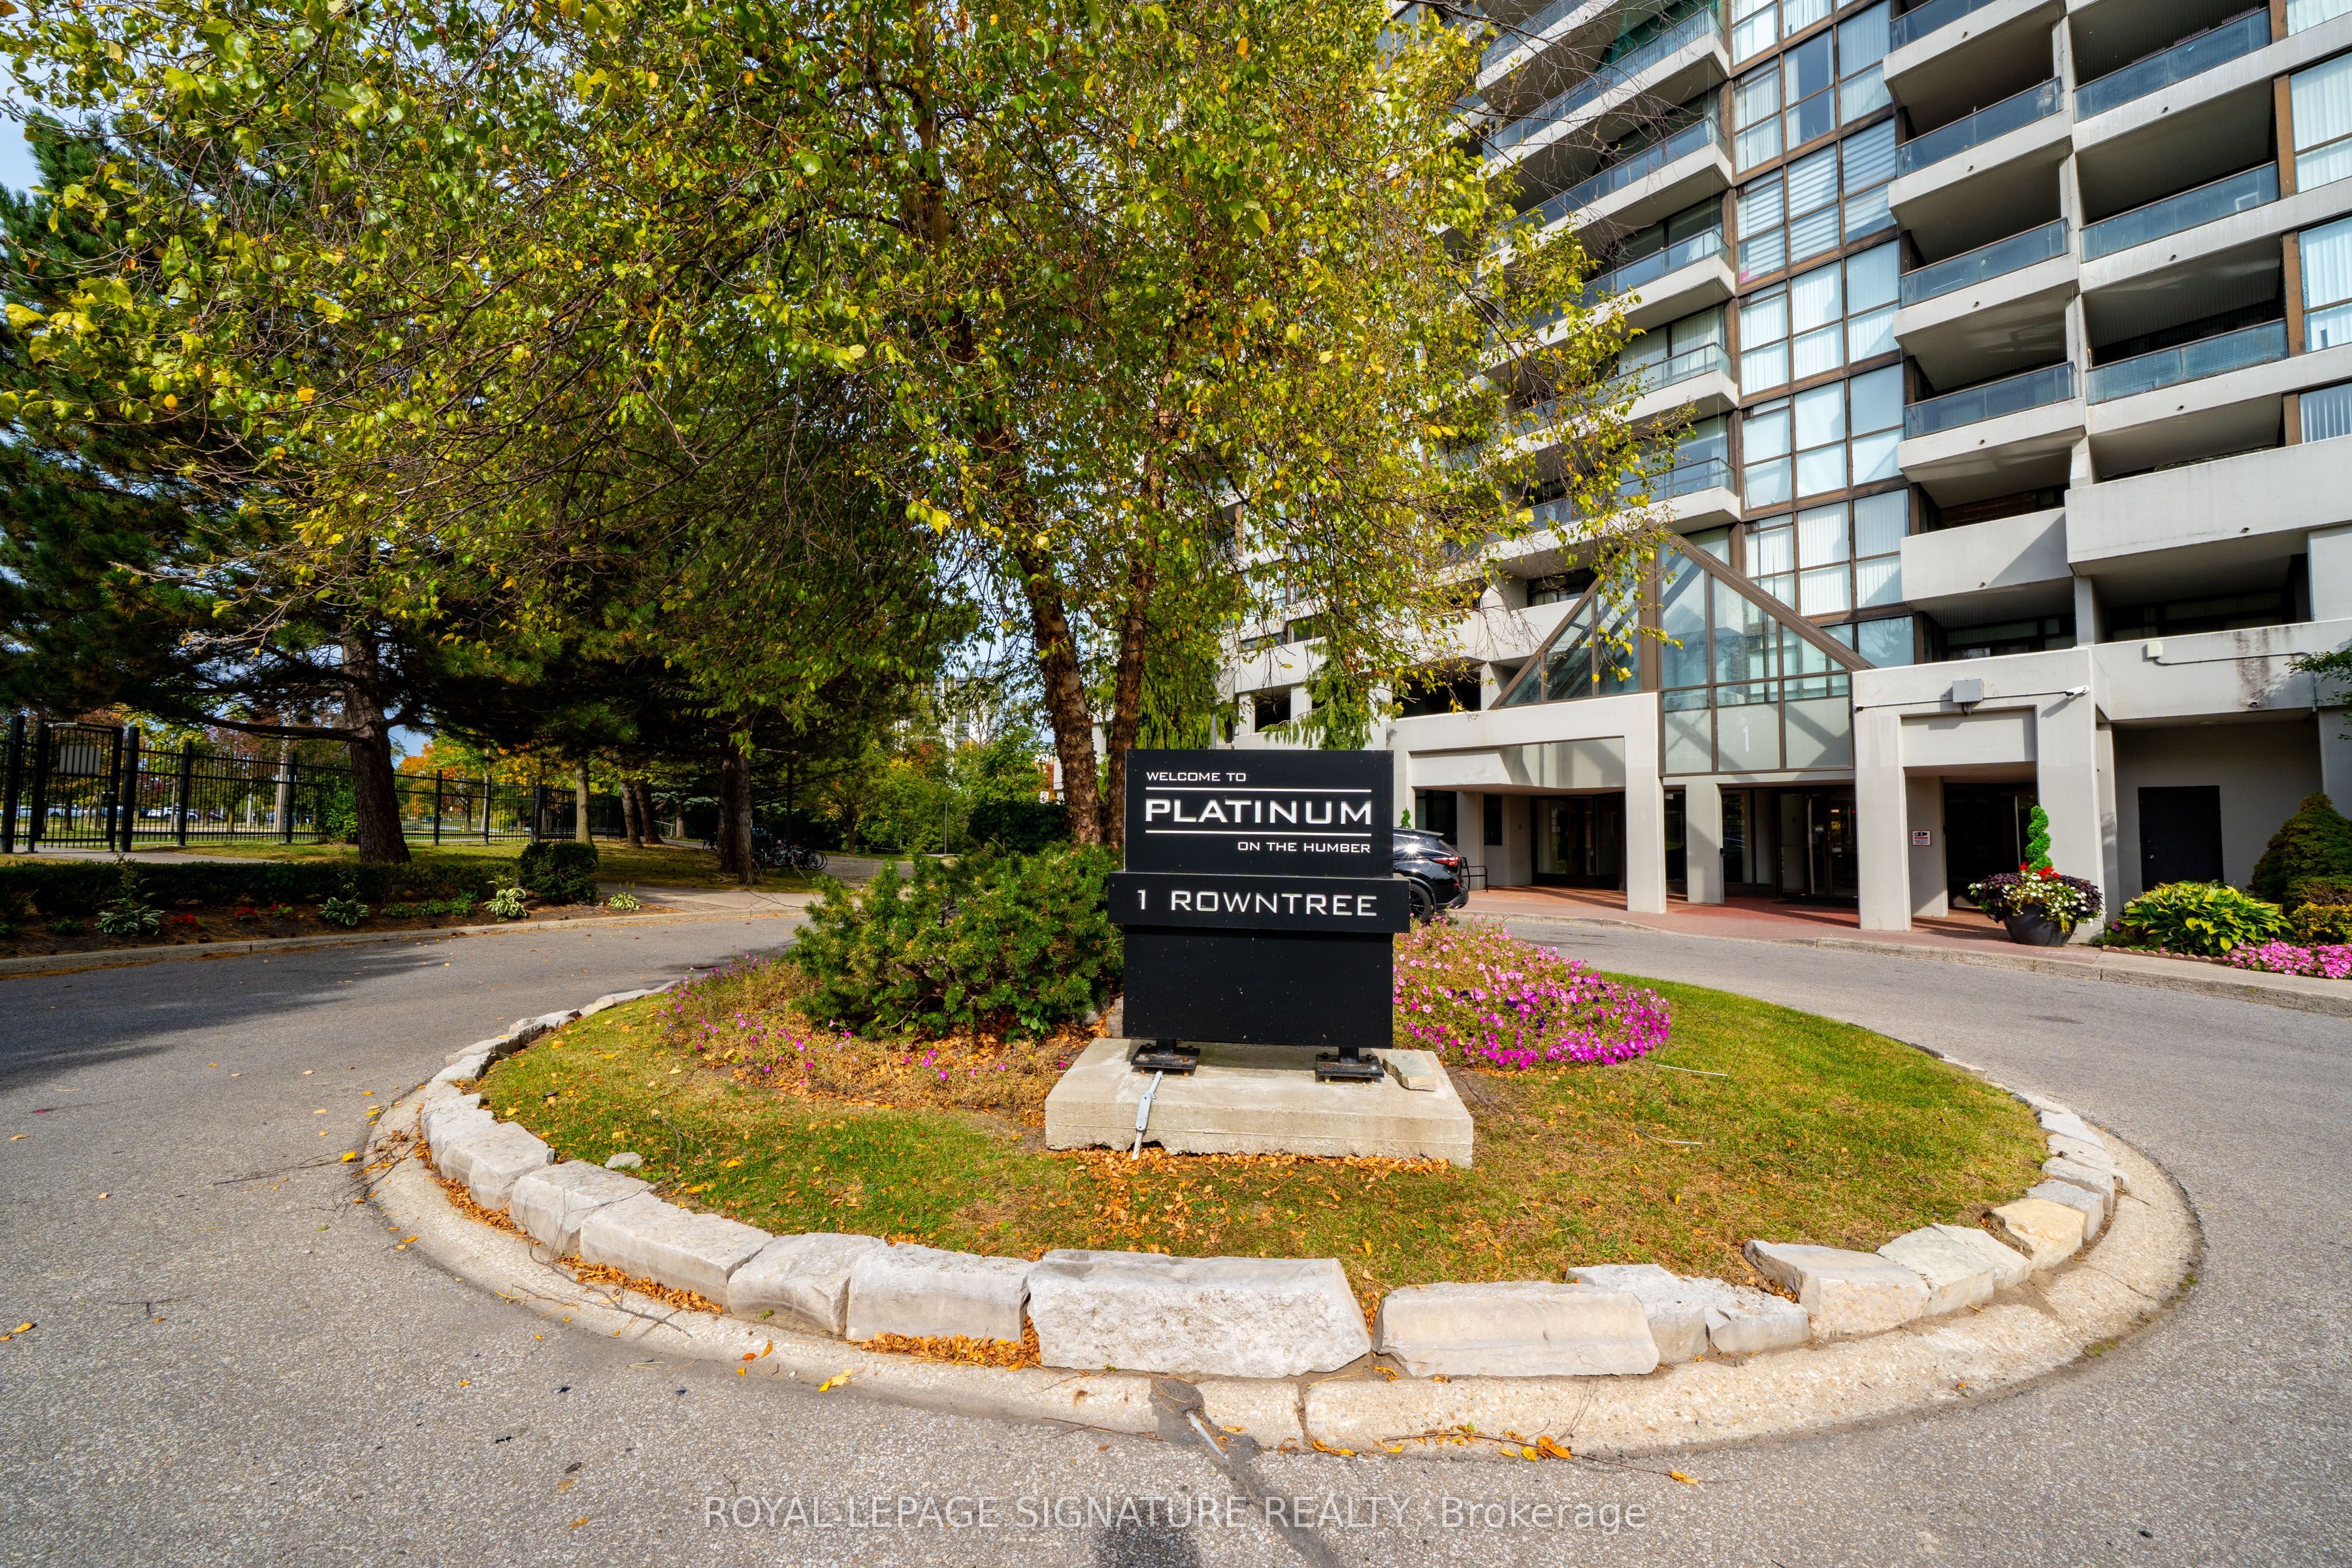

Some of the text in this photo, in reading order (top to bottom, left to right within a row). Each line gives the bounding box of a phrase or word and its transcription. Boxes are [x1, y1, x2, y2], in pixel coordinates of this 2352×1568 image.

[1147, 772, 1247, 782] WELCOME TO
[1145, 798, 1372, 825] PLATINUM
[1238, 841, 1371, 853] ON THE HUMBER
[1137, 889, 1377, 916] 1 ROWNTREE
